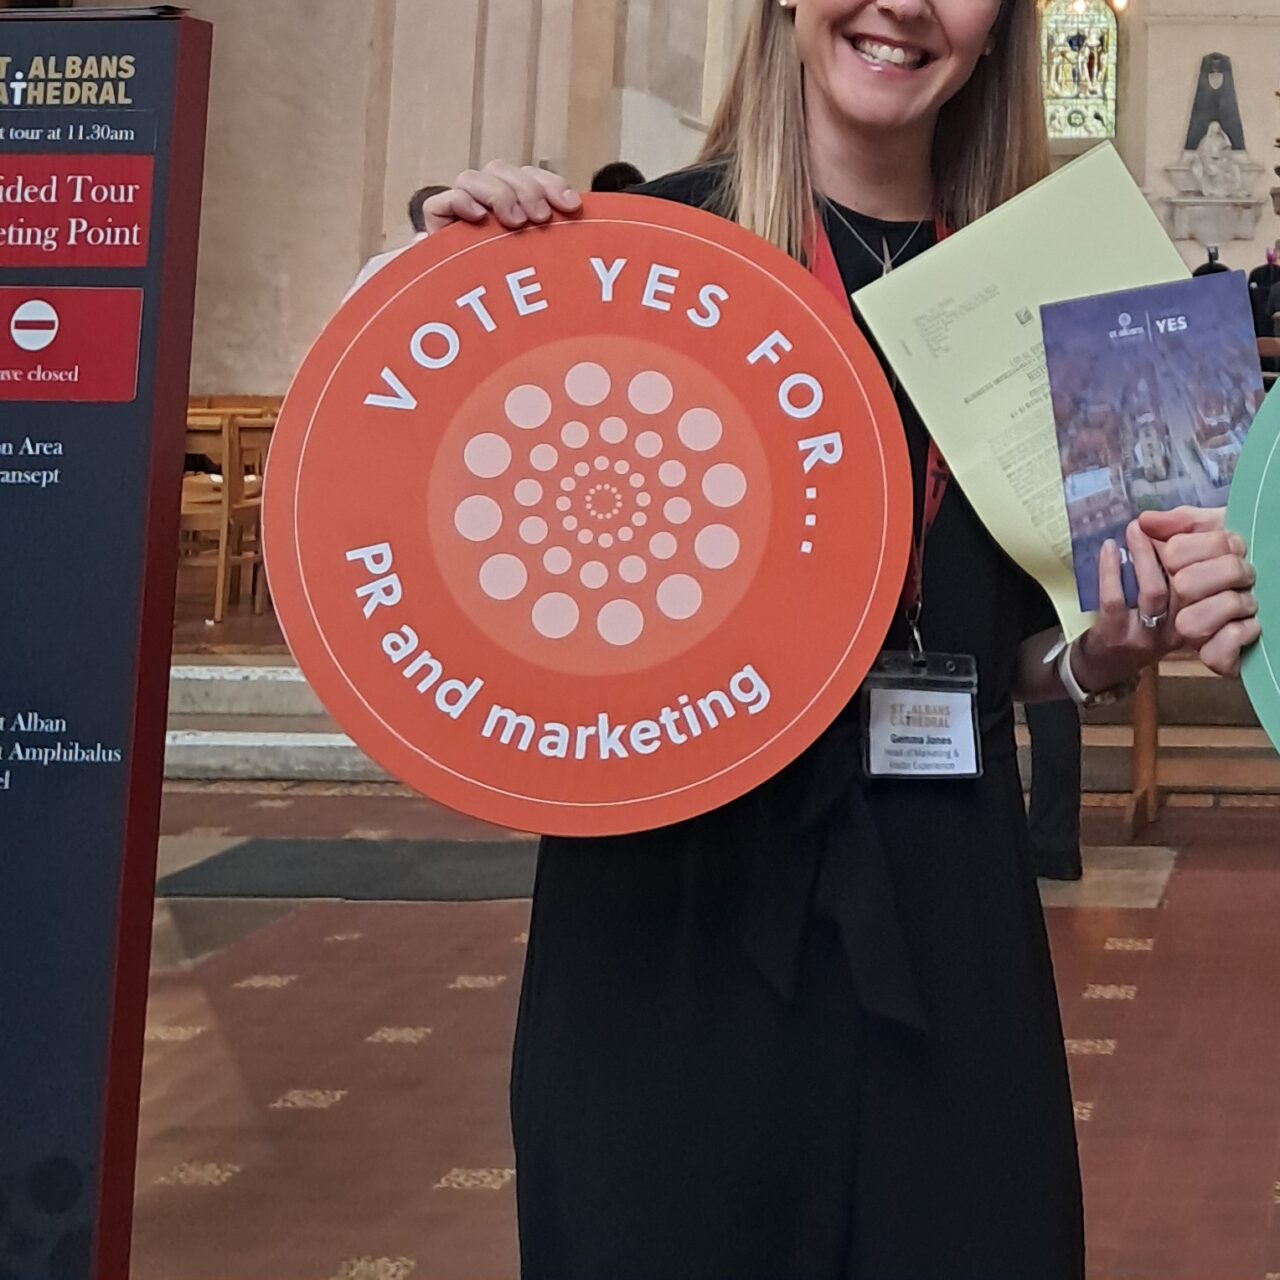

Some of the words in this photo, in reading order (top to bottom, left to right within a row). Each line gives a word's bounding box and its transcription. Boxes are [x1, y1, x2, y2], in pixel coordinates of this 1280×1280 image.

[27, 55, 136, 80] ALBANS
[9, 127, 44, 141] tour
[46, 127, 62, 141] at
[68, 124, 135, 141] 11.30am
[66, 175, 140, 204] Tour
[66, 217, 142, 246] Point
[1155, 316, 1188, 335] YES
[27, 364, 79, 382] closed
[364, 267, 549, 410] VOTE
[590, 258, 729, 328] YES
[746, 330, 843, 554] FOR...
[18, 436, 64, 456] Area
[346, 542, 402, 619] PR
[381, 625, 484, 720] and
[481, 664, 771, 760] marketing
[8, 711, 67, 733] Alban
[7, 741, 122, 767] Amphibalus
